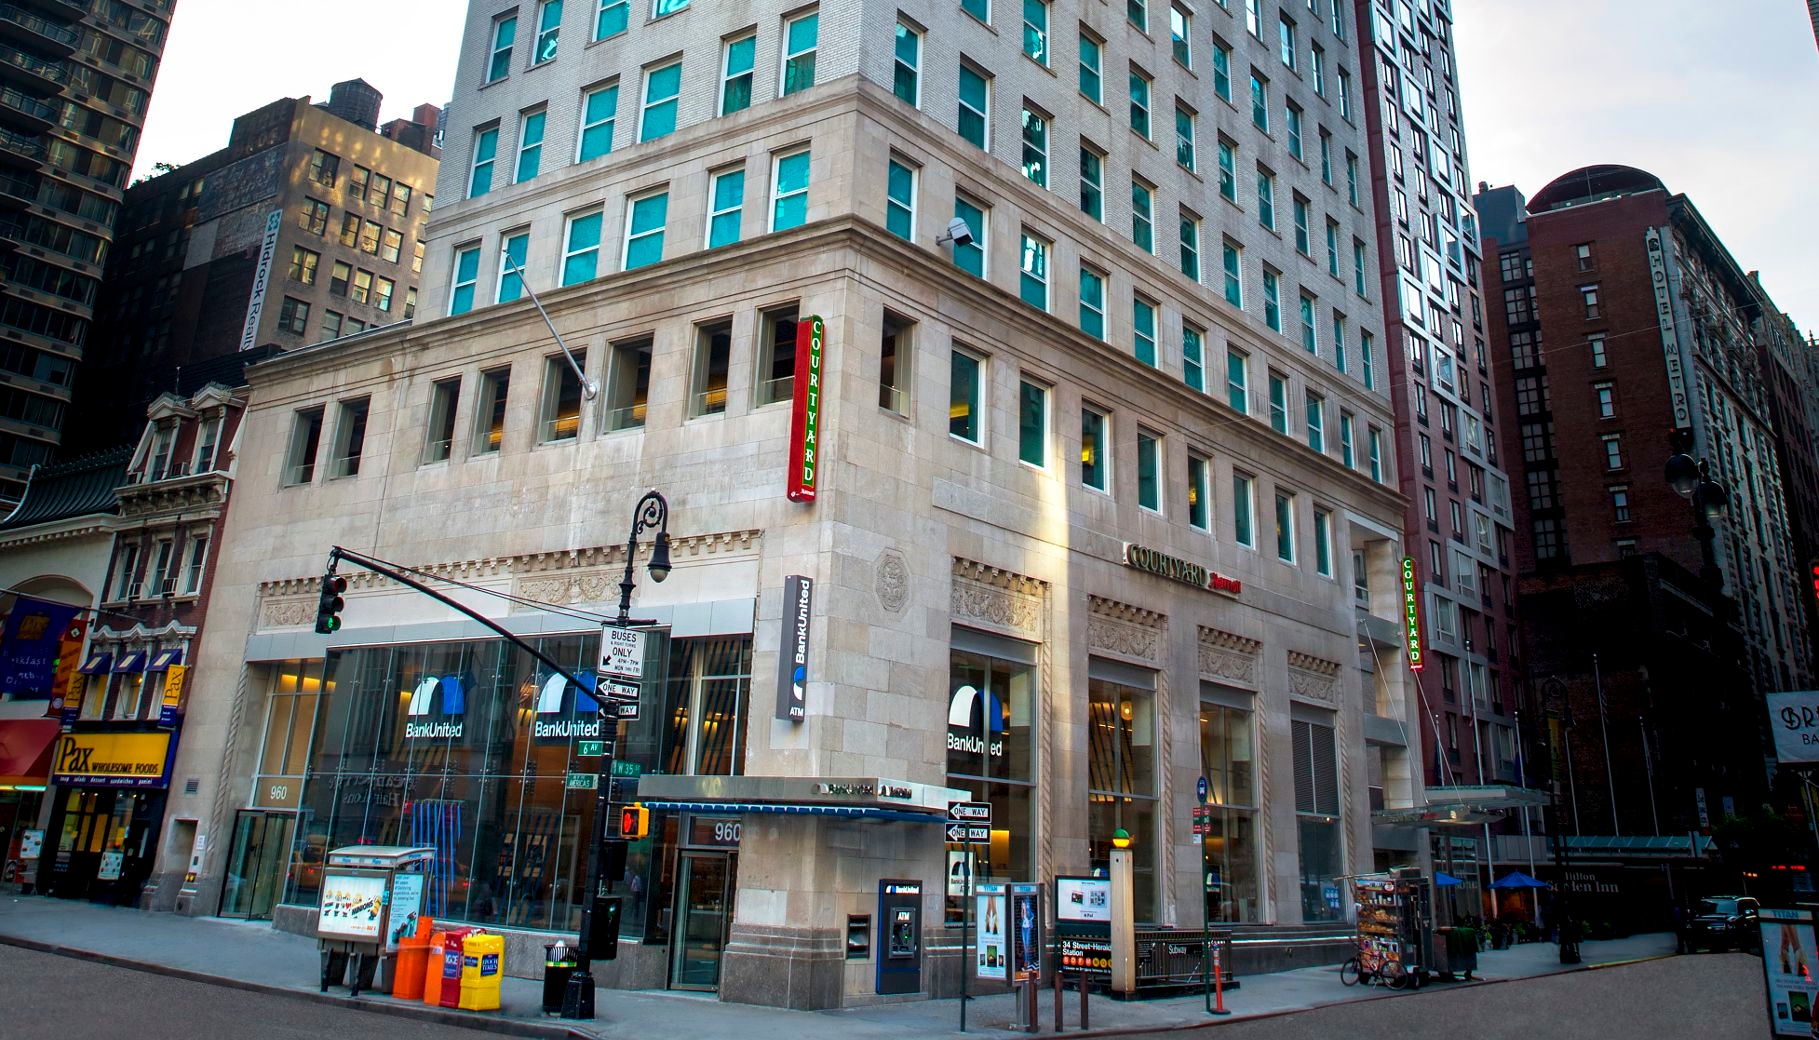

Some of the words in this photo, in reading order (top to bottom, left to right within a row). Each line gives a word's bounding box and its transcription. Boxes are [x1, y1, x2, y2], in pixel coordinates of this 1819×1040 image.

[253, 233, 276, 300] Hidrock
[1650, 254, 1672, 331] HOTEL
[1665, 343, 1687, 421] METRO
[803, 320, 821, 481] COURTYARD
[1126, 543, 1209, 587] COURTYARD
[1403, 559, 1420, 660] COURTYARD
[795, 579, 811, 664] BankUnited
[611, 630, 637, 643] BUSES
[612, 646, 632, 658] ONLY
[66, 674, 84, 703] Pax
[164, 671, 182, 701] Pax
[602, 683, 617, 693] ONE
[621, 685, 635, 695] WAY
[789, 706, 804, 717] ATM
[1780, 706, 1819, 730] BR
[405, 721, 463, 738] BankUnited
[534, 719, 600, 738] BankUnited
[583, 744, 589, 755] 6
[590, 743, 599, 751] AV
[947, 733, 1003, 757] BankUned
[57, 737, 94, 772] Pax
[92, 762, 133, 772] WHOLESOME
[134, 763, 159, 774] FOODS
[617, 762, 624, 775] W
[624, 763, 634, 775] 35
[270, 785, 288, 800] 960
[953, 807, 967, 816] ONE
[971, 807, 986, 816] WAY
[715, 822, 742, 841] 960
[951, 828, 966, 838] ONE
[970, 829, 985, 838] WAY
[1595, 880, 1620, 893] Inn
[897, 911, 910, 921] ATM
[1062, 941, 1071, 949] 34
[1062, 948, 1084, 957] Station
[1168, 944, 1188, 955] Subway
